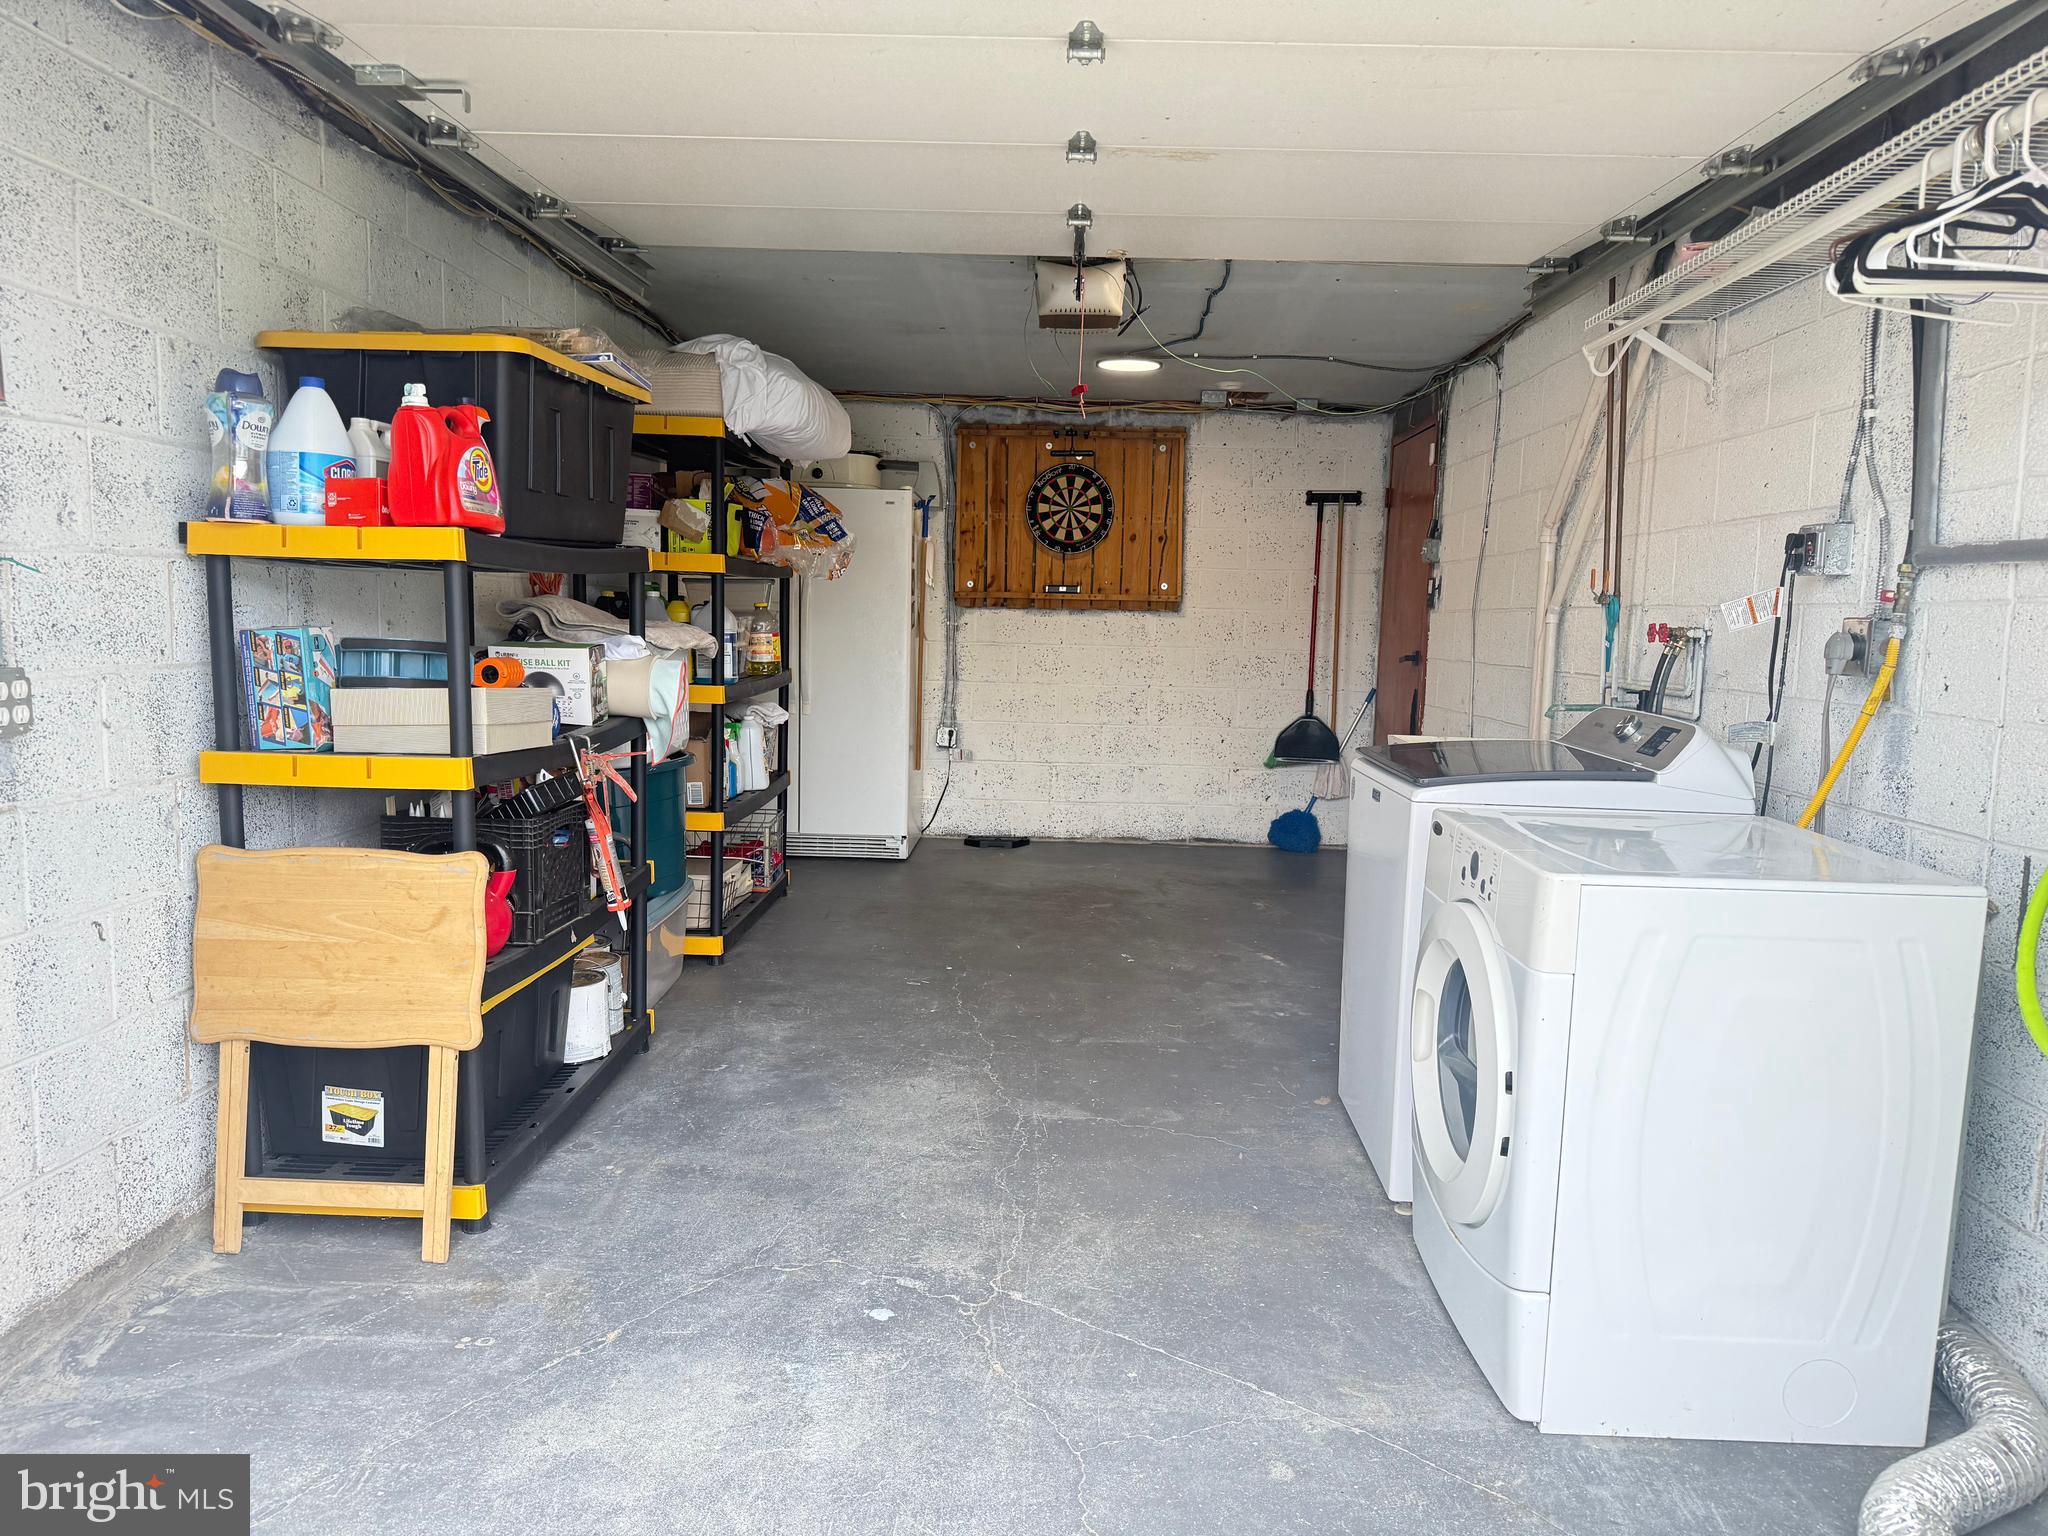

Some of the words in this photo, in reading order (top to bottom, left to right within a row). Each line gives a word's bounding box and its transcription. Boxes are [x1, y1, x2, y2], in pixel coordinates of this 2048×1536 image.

[242, 420, 269, 433] Down
[472, 460, 488, 481] Tide
[535, 659, 556, 667] BALL
[558, 659, 571, 667] KIT
[361, 1090, 379, 1099] BOX
